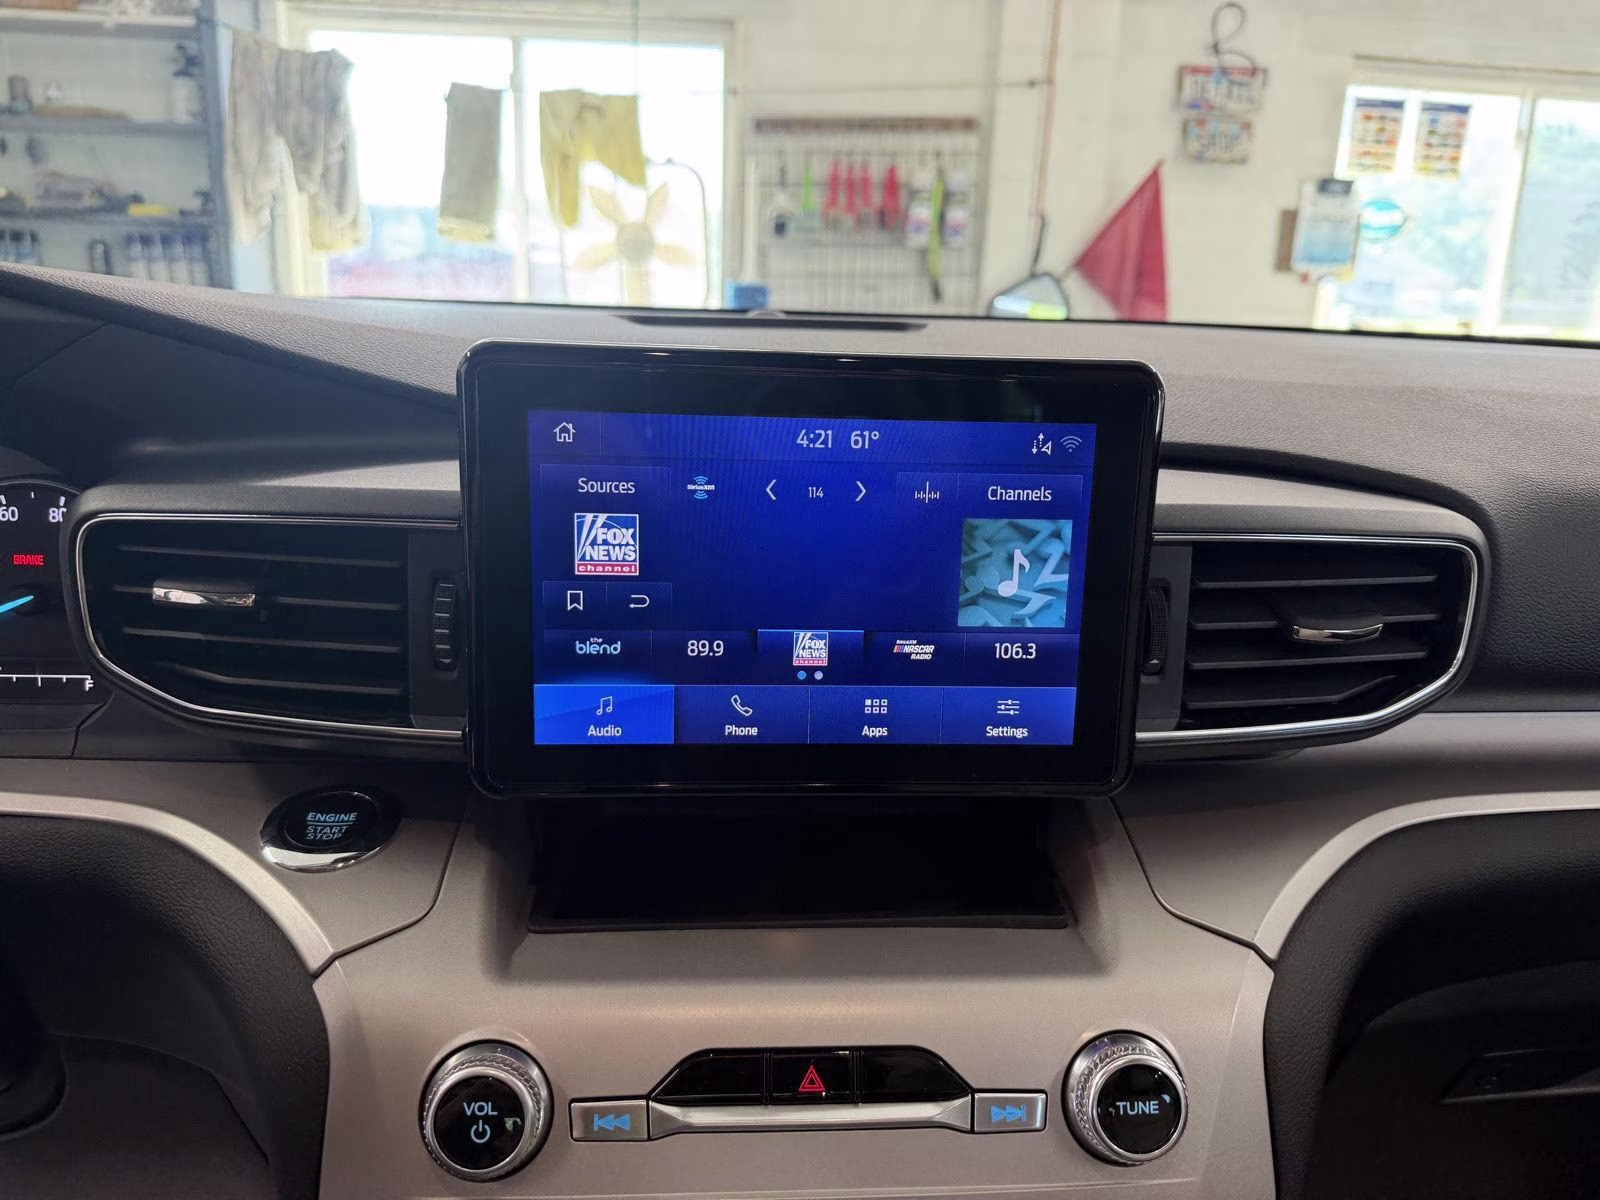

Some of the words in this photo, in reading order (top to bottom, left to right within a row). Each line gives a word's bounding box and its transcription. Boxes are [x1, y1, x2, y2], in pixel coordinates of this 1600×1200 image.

[796, 429, 833, 449] 4:21
[850, 430, 880, 449] 61°
[577, 477, 636, 495] Sources
[808, 486, 825, 498] 114
[987, 485, 1053, 501] Channels
[0, 506, 19, 521] 60
[596, 527, 636, 545] FOX
[13, 554, 45, 566] BRAKE
[585, 545, 637, 562] NEWS
[578, 564, 636, 573] channel
[575, 640, 622, 655] blend
[687, 640, 725, 657] 89.9
[805, 639, 826, 649] FOX
[903, 644, 936, 654] NASCAR
[799, 649, 826, 658] NEWS
[994, 642, 1037, 660] 106.3
[85, 679, 95, 692] F
[587, 724, 622, 737] Audio
[725, 725, 758, 736] Phone
[861, 725, 888, 738] Apps
[985, 725, 1029, 739] Settings
[306, 812, 358, 822] ENGINE
[306, 825, 350, 834] START
[463, 1101, 498, 1116] VOL
[1115, 1101, 1160, 1116] TUNE
